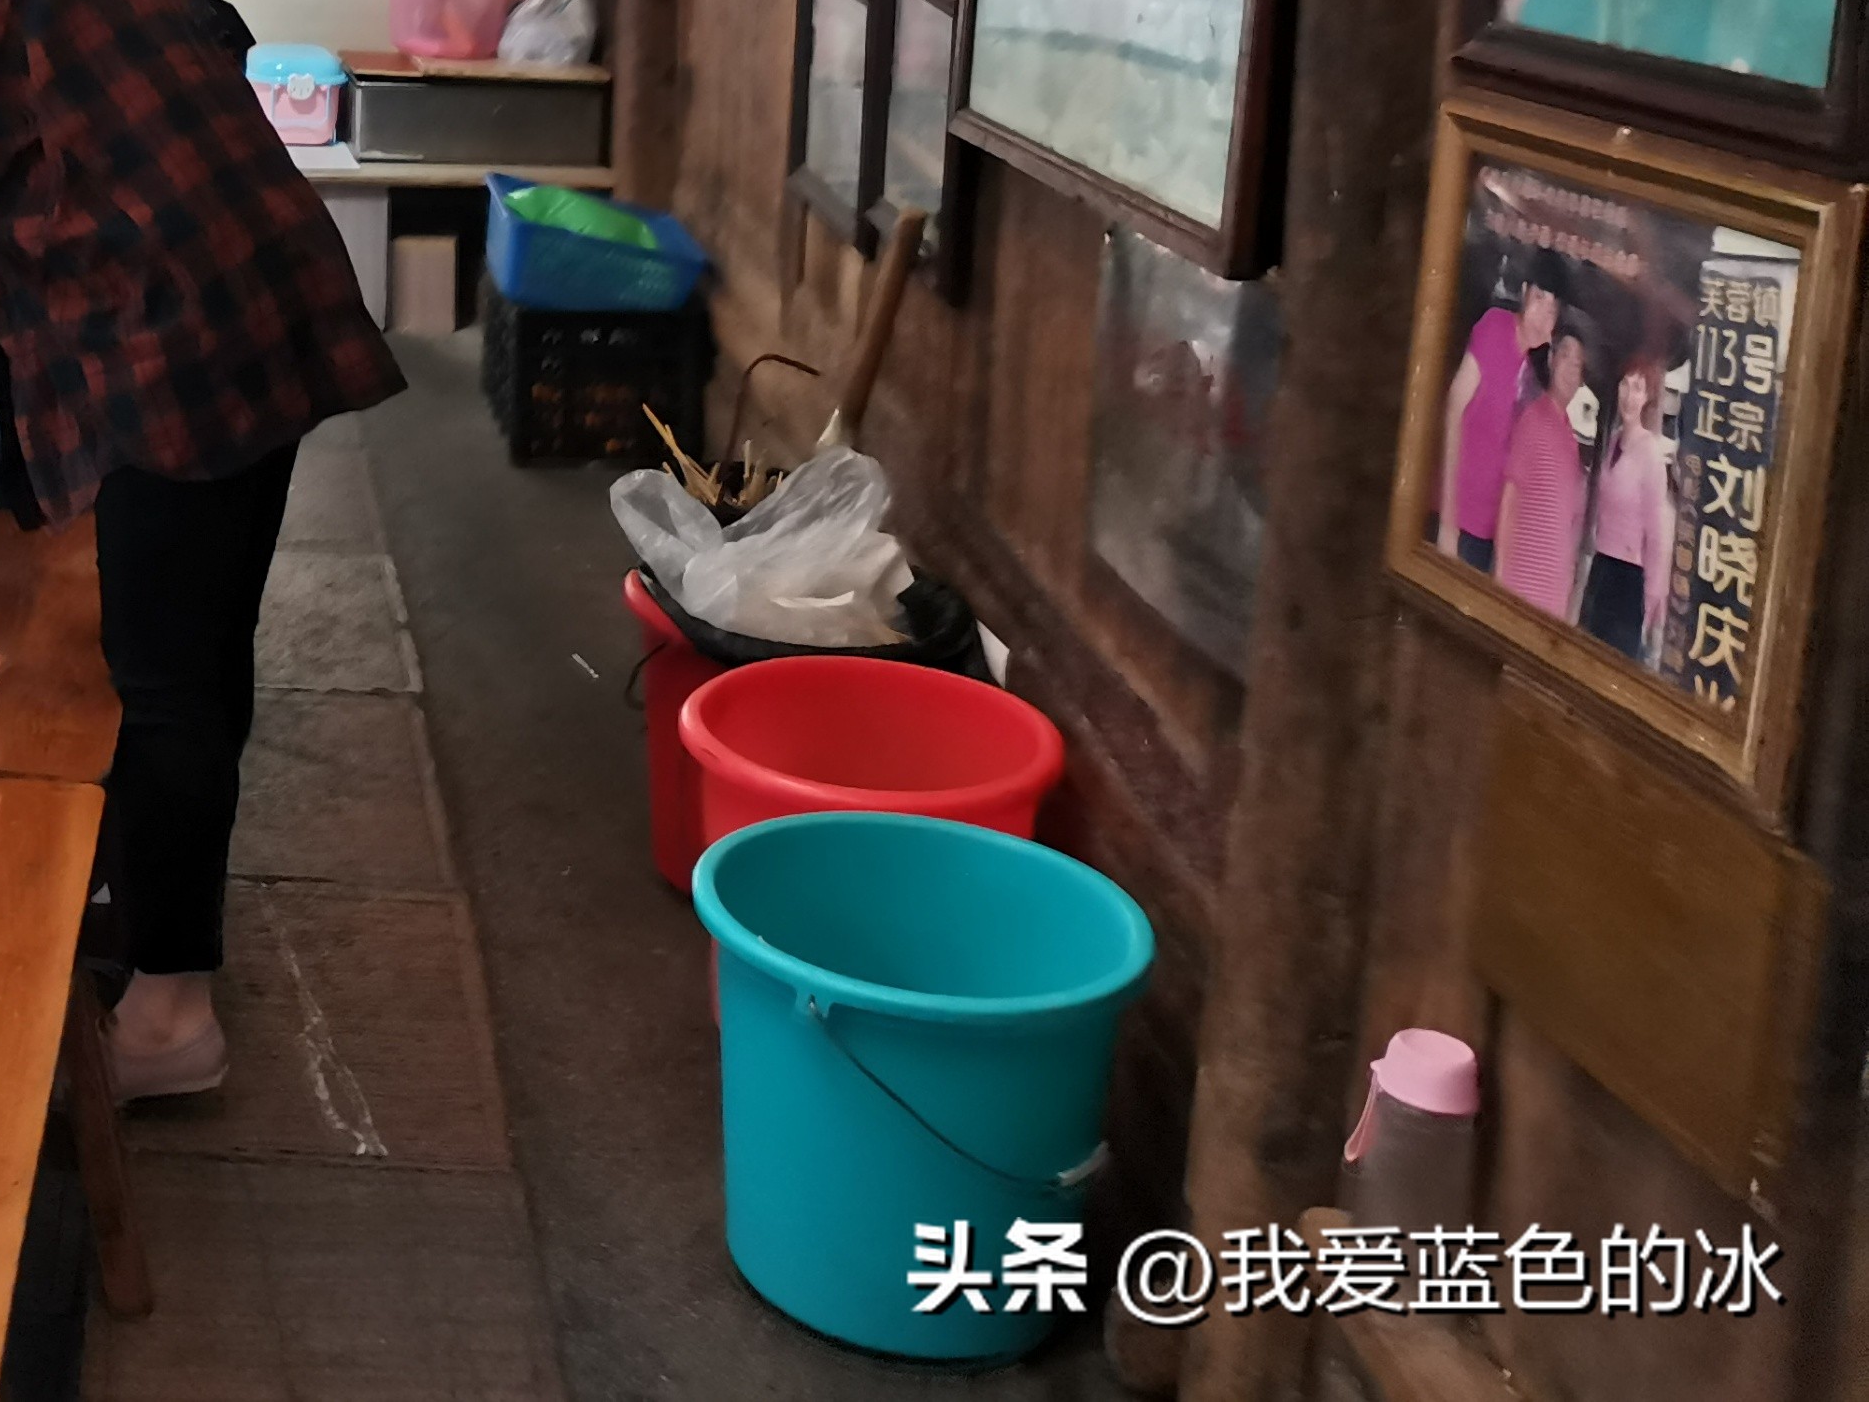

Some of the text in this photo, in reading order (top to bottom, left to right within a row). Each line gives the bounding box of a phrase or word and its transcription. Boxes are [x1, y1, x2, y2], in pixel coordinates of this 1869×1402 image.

[1695, 323, 1776, 395] 113号
[1692, 389, 1766, 453] 正宗
[1688, 453, 1766, 710] 刘晓庆
